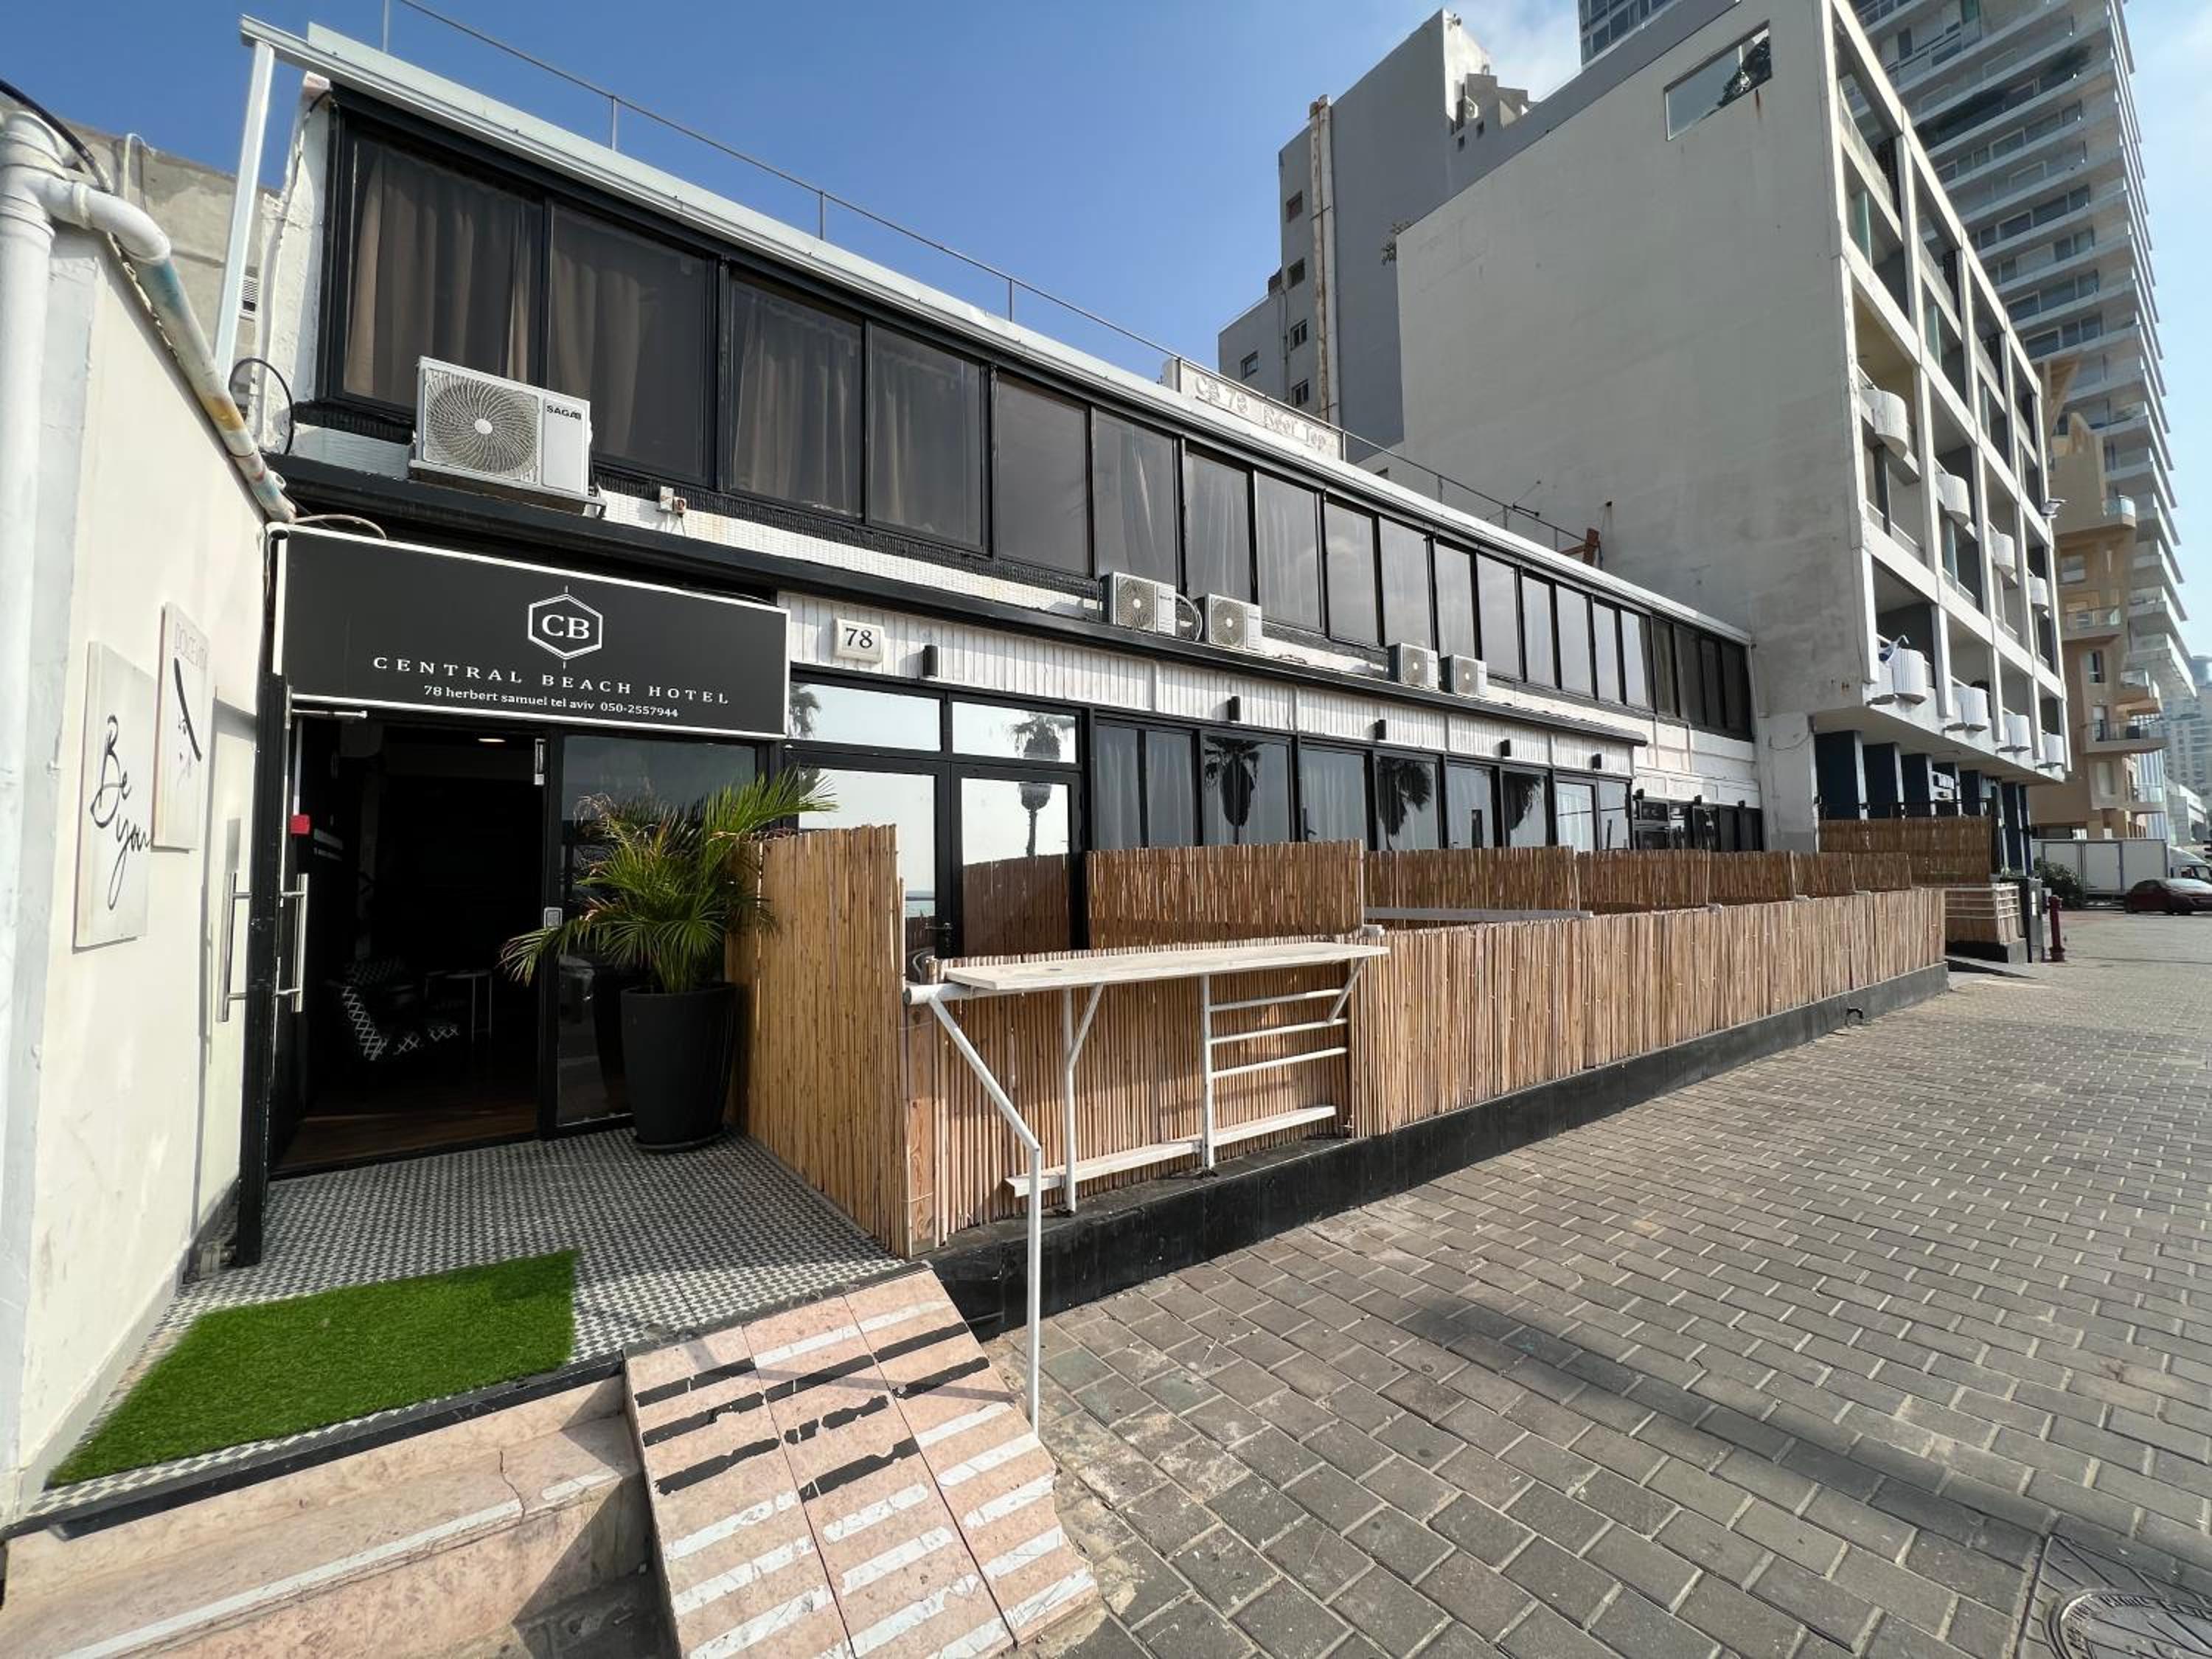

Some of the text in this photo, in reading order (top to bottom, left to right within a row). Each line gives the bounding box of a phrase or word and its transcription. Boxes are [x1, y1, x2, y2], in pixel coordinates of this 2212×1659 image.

[542, 614, 590, 639] CB
[846, 627, 873, 649] 78
[373, 657, 728, 704] CENTRAL BEACH HOTEL
[424, 685, 678, 717] 78 herbert samuel tel aviv 050-2557944
